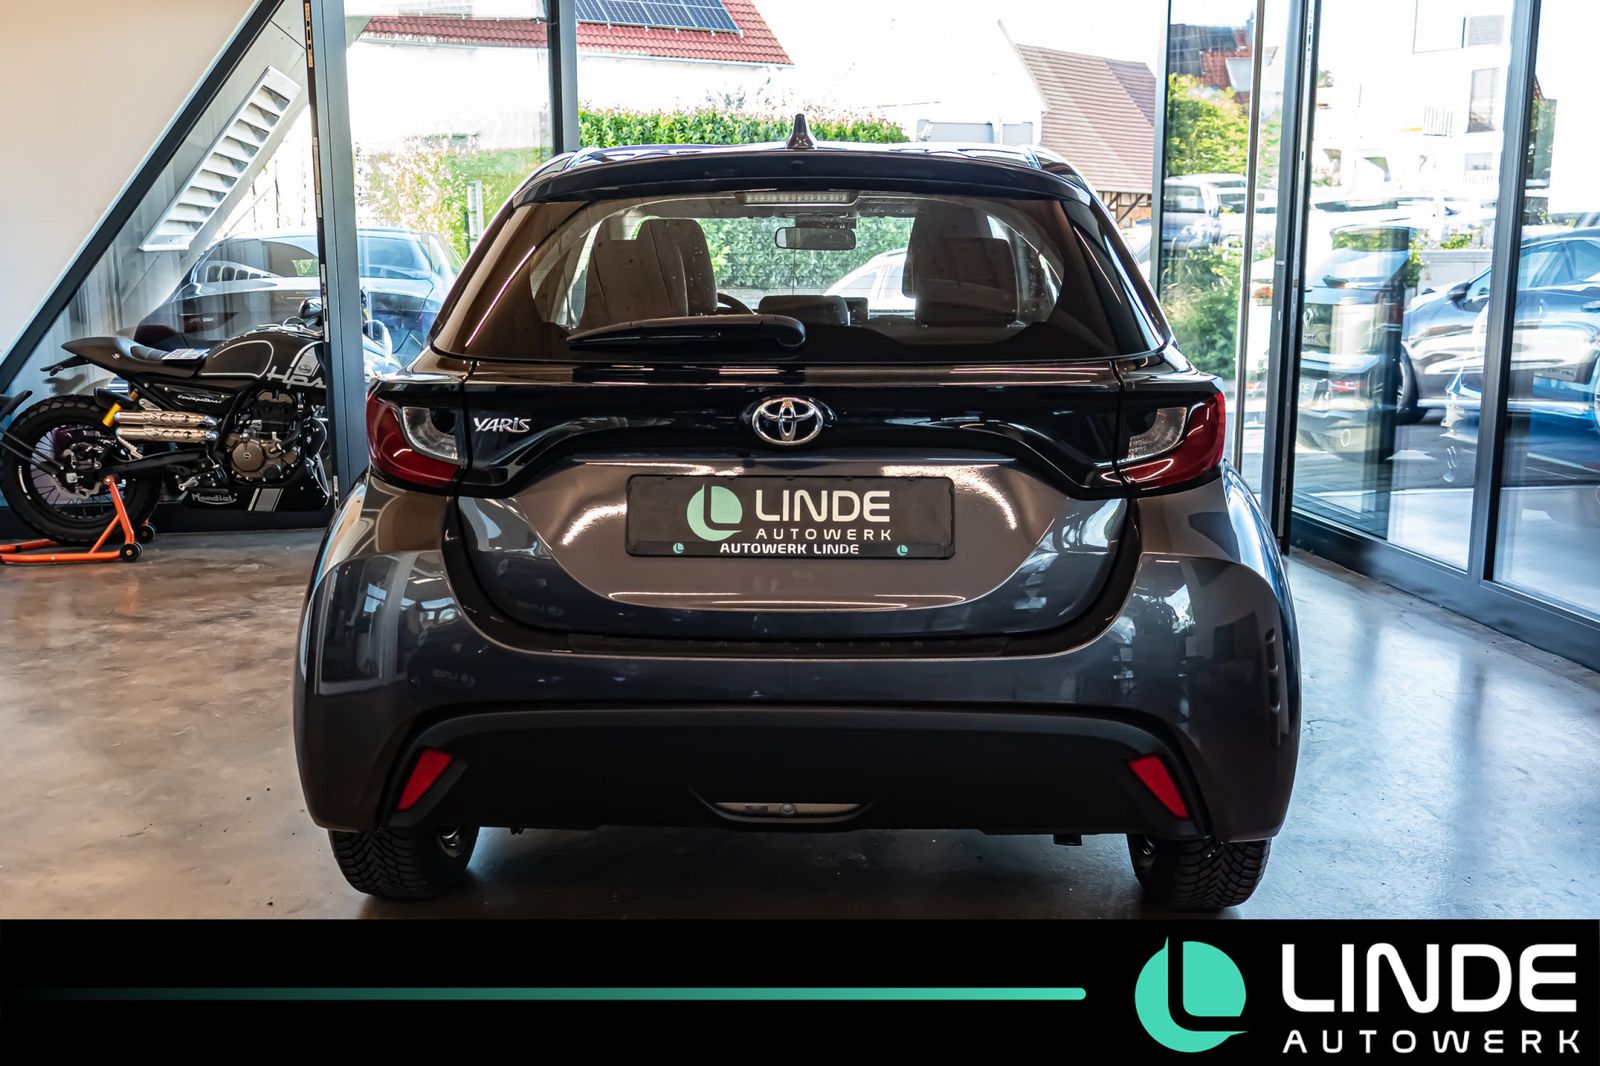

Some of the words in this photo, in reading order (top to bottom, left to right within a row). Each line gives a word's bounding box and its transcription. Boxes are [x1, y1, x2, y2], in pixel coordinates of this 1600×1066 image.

[755, 489, 891, 522] LINDE
[755, 527, 892, 541] AUTOWERK
[719, 542, 807, 555] AUTOWERK
[813, 543, 860, 555] LINDE
